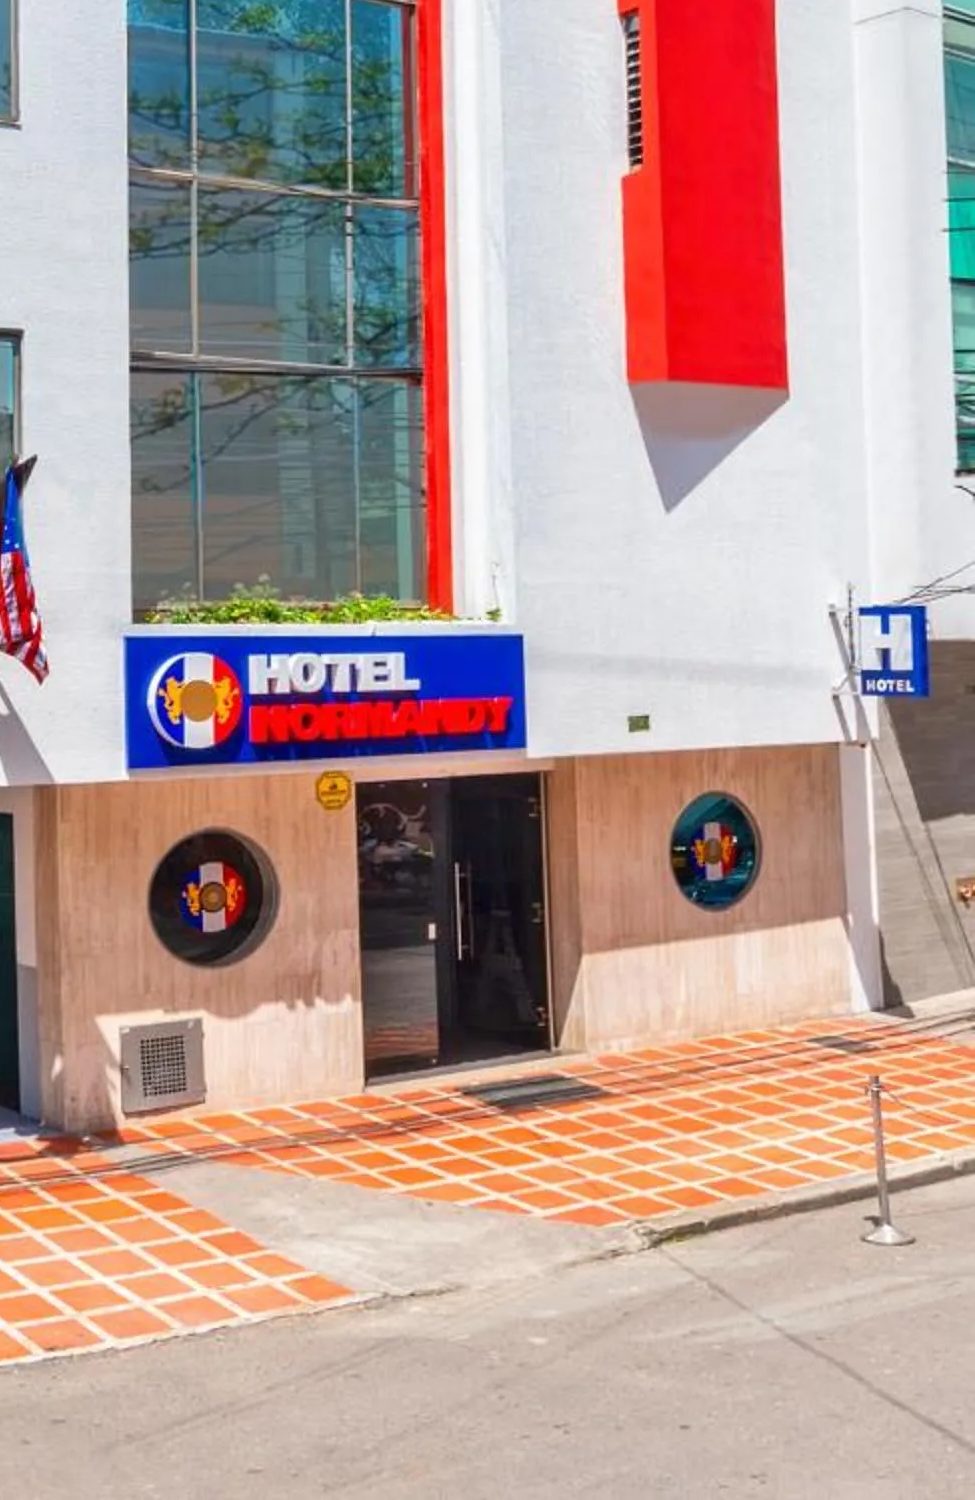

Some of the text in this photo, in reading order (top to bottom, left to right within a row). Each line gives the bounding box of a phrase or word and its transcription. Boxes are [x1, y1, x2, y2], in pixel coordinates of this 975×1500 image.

[860, 613, 913, 671] H
[248, 652, 421, 695] HOTEL
[865, 679, 915, 693] HOTEL
[248, 697, 513, 745] NORMANDY
